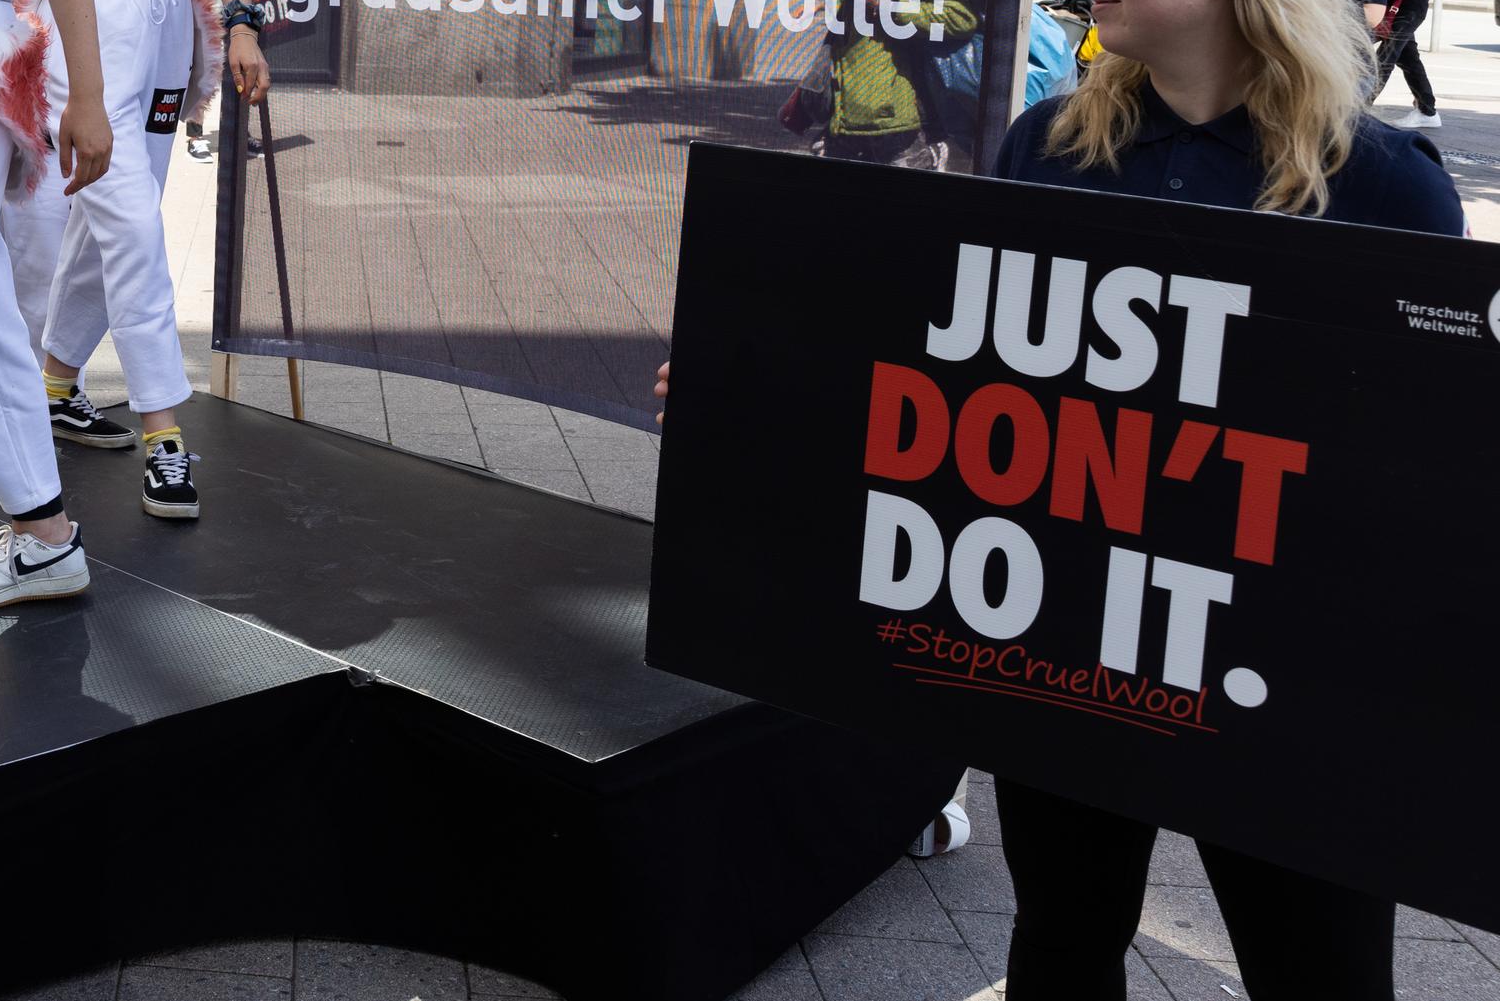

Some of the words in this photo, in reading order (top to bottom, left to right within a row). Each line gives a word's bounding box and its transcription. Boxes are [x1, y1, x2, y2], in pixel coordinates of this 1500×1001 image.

[154, 112, 168, 122] DO
[161, 94, 178, 103] JUST
[926, 243, 1252, 408] JUST
[1396, 299, 1483, 323] Tierschutz.
[1408, 316, 1482, 338] Weltweit.
[863, 361, 1309, 566] DON'T
[859, 489, 1044, 640] DO
[1100, 546, 1268, 708] IT.
[877, 619, 1208, 723] #StopCruelWool
